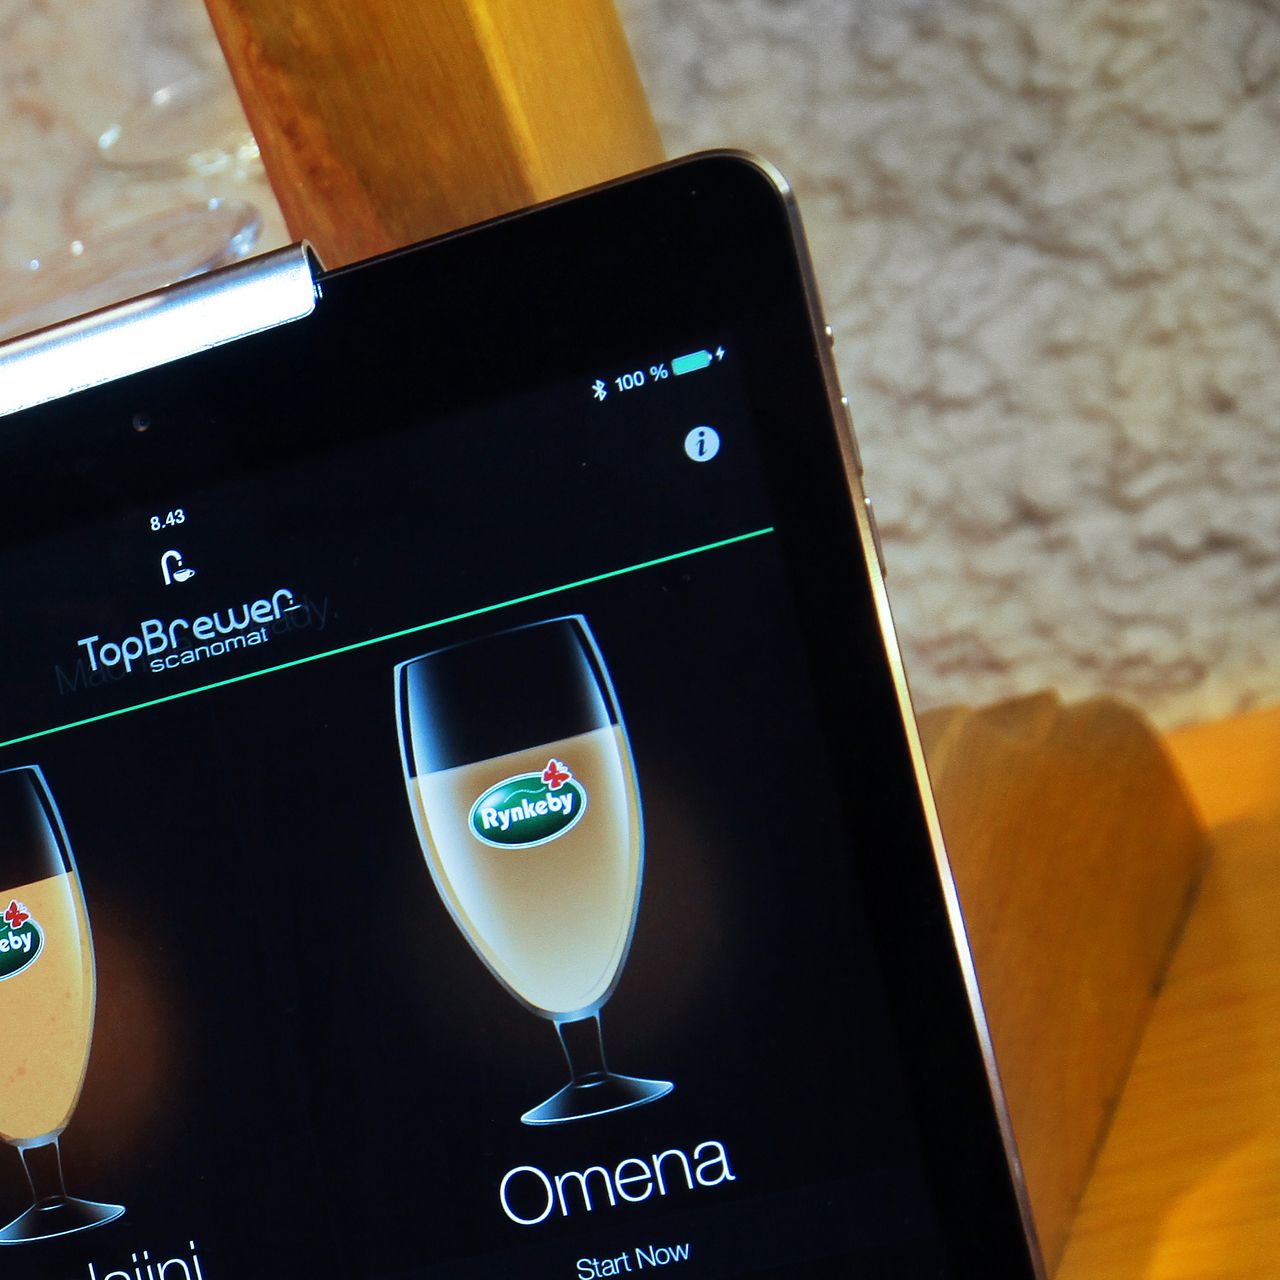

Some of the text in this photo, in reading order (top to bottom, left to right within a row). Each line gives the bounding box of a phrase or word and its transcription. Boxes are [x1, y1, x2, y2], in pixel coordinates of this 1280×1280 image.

[614, 363, 669, 392] 100 %
[150, 508, 186, 532] 8.43
[77, 587, 302, 673] TopBrewer
[149, 626, 269, 674] scanomat
[480, 792, 574, 831] Rynkeby
[499, 1139, 738, 1226] Omena
[635, 1242, 691, 1270] Now
